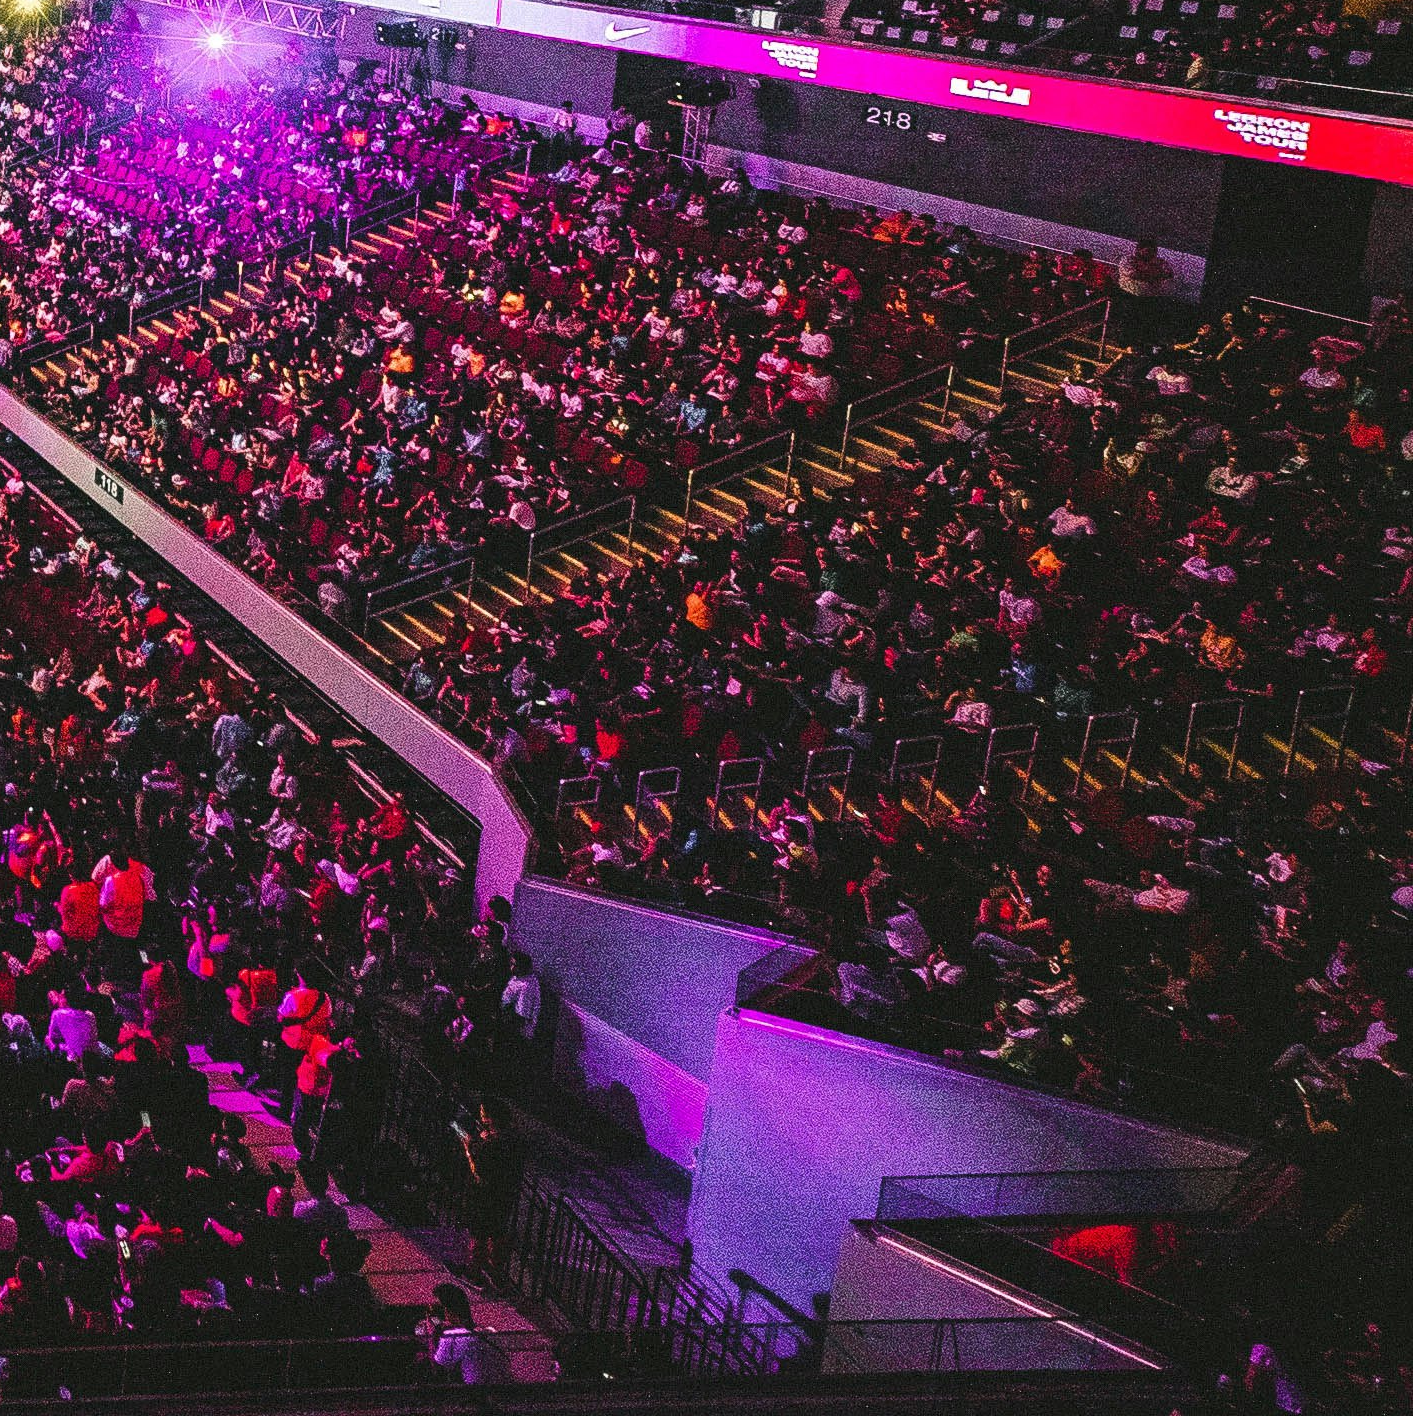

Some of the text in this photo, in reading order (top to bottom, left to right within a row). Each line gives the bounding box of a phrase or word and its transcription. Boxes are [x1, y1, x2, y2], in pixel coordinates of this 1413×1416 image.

[866, 107, 911, 131] 218
[1214, 109, 1311, 132] LEBRON
[1227, 123, 1309, 142] JAMES
[1240, 132, 1308, 151] TOUR
[101, 474, 118, 498] 118
